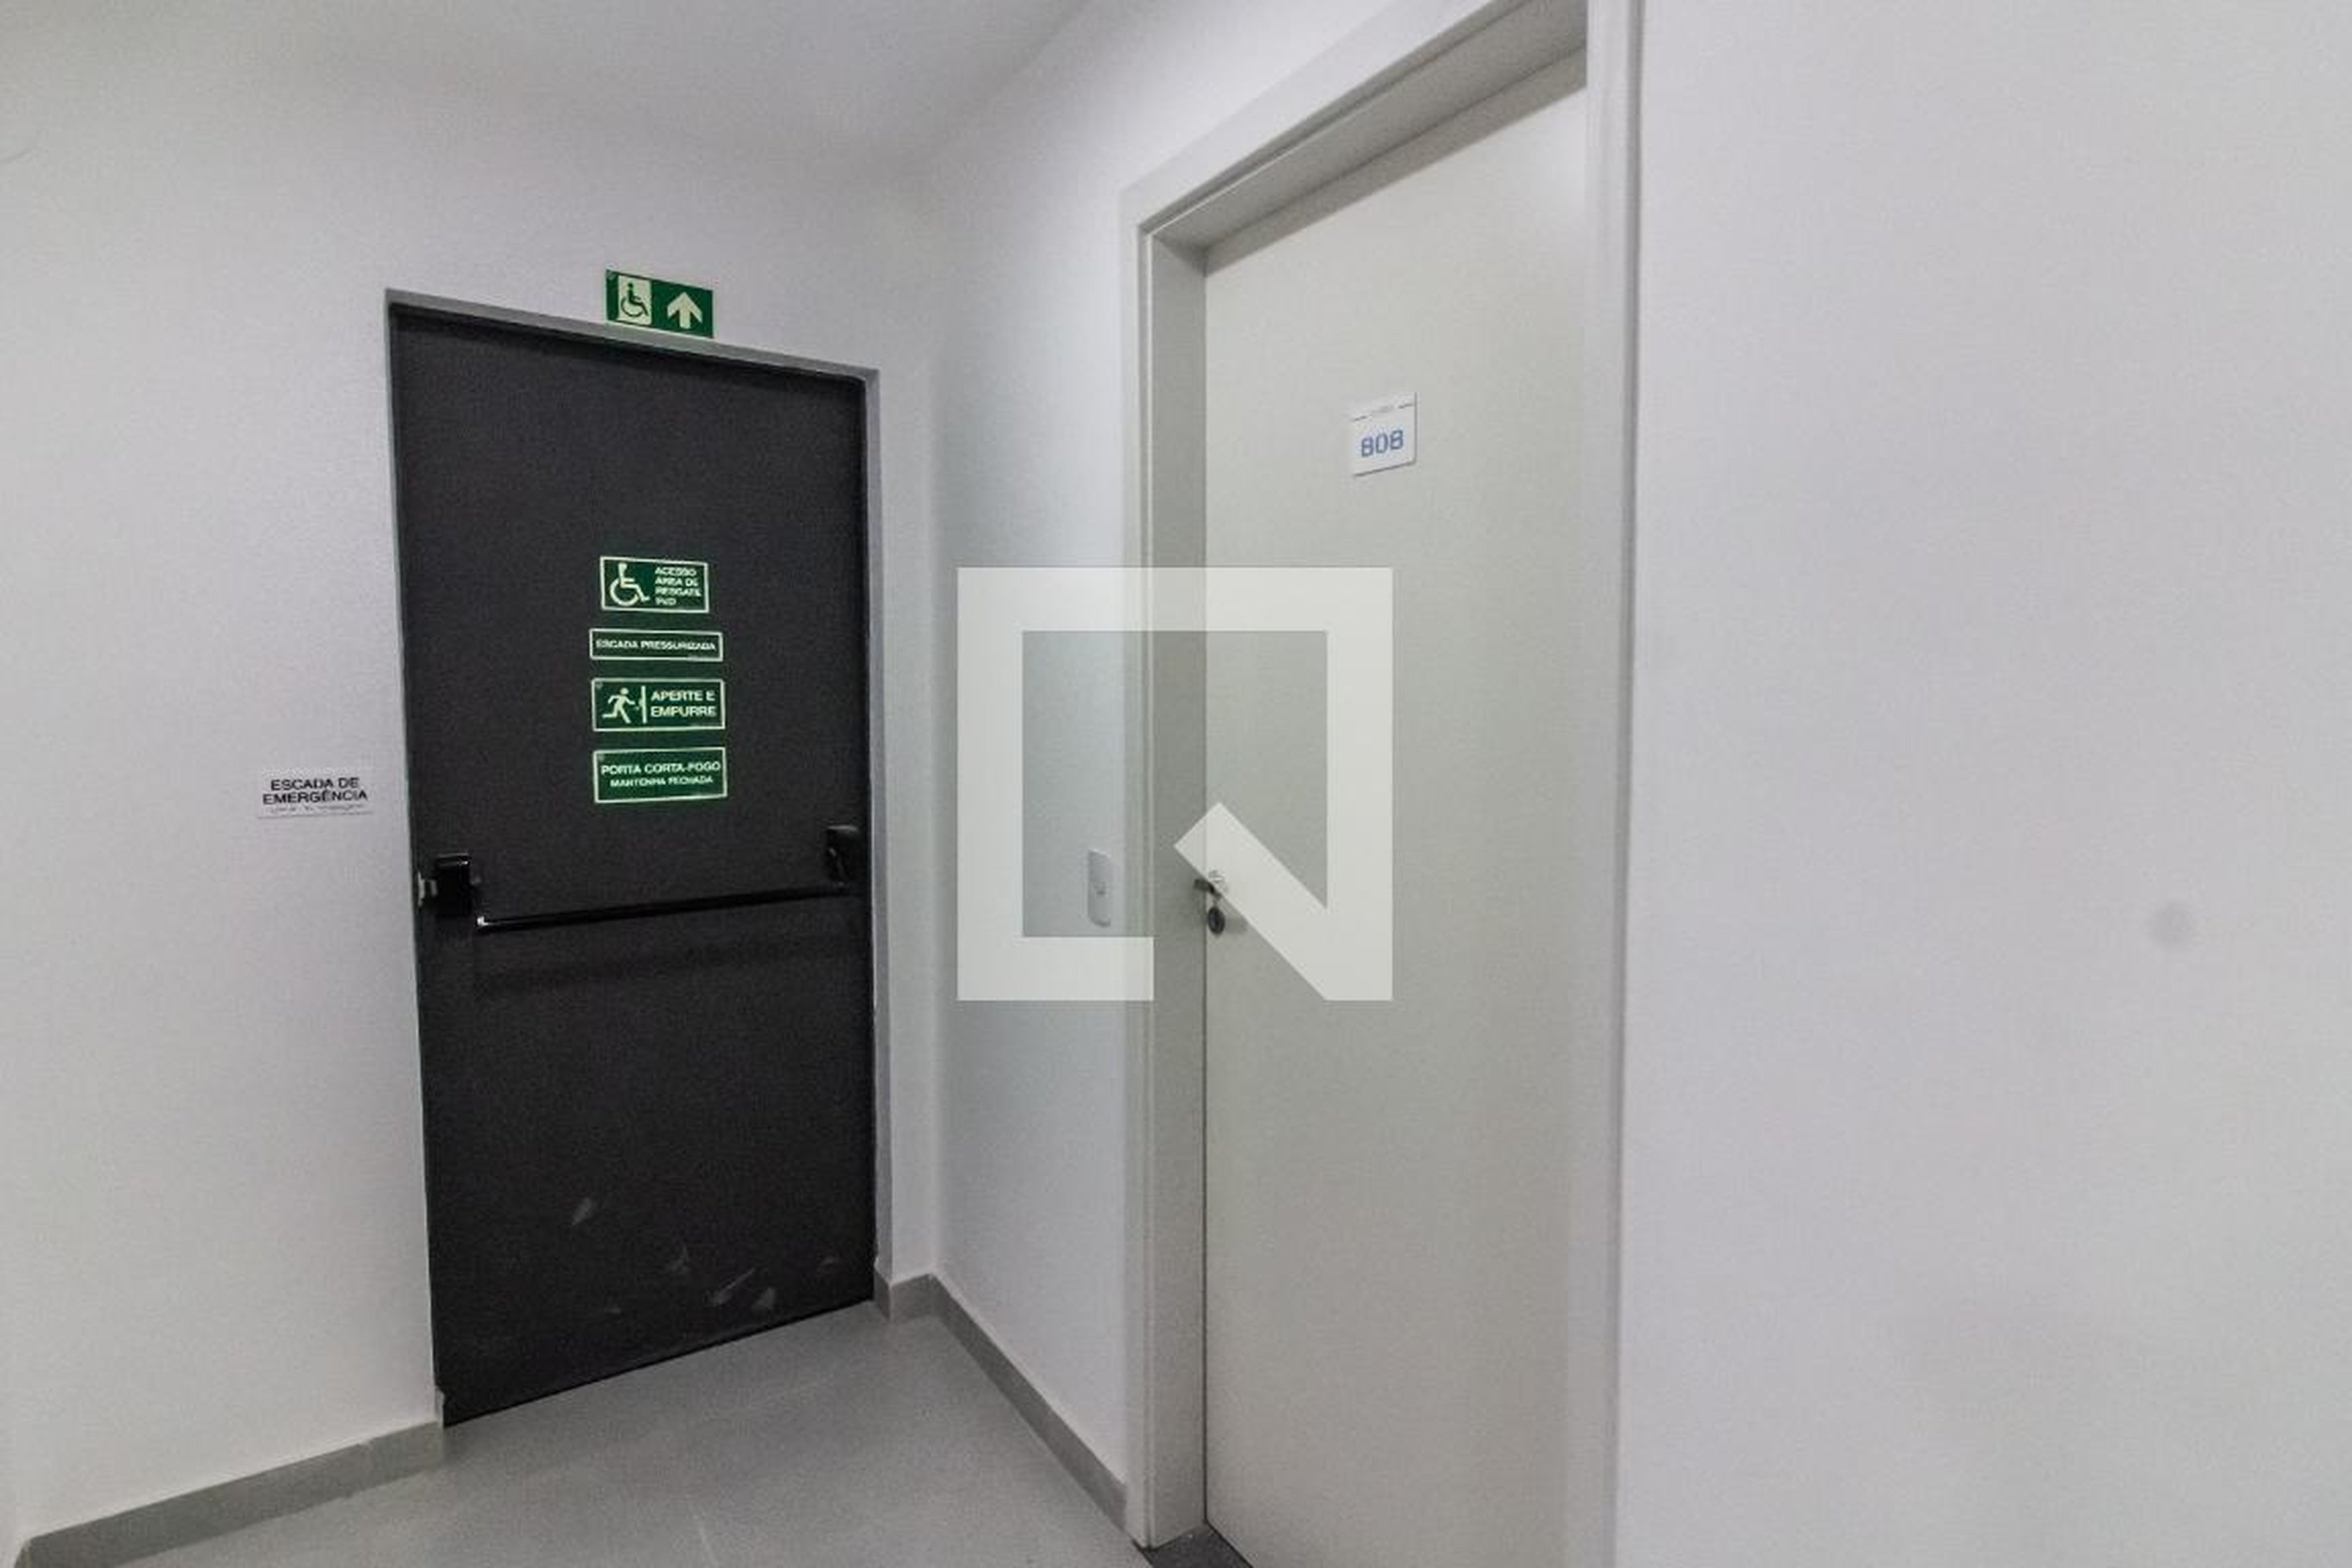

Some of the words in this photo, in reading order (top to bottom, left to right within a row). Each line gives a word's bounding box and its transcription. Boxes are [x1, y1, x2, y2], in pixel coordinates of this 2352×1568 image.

[595, 639, 639, 649] ESCADA
[640, 640, 717, 651] PRESSURIZADA
[650, 690, 703, 701] APERTE
[706, 690, 715, 701] E
[650, 706, 717, 718] EMPURRE
[601, 764, 642, 775] PORTA
[644, 761, 721, 774] CORTA-FOGO
[271, 778, 334, 791] ESCADA
[337, 777, 360, 788] DE
[610, 777, 666, 788] MANTENHA
[668, 775, 713, 785] FECHADA
